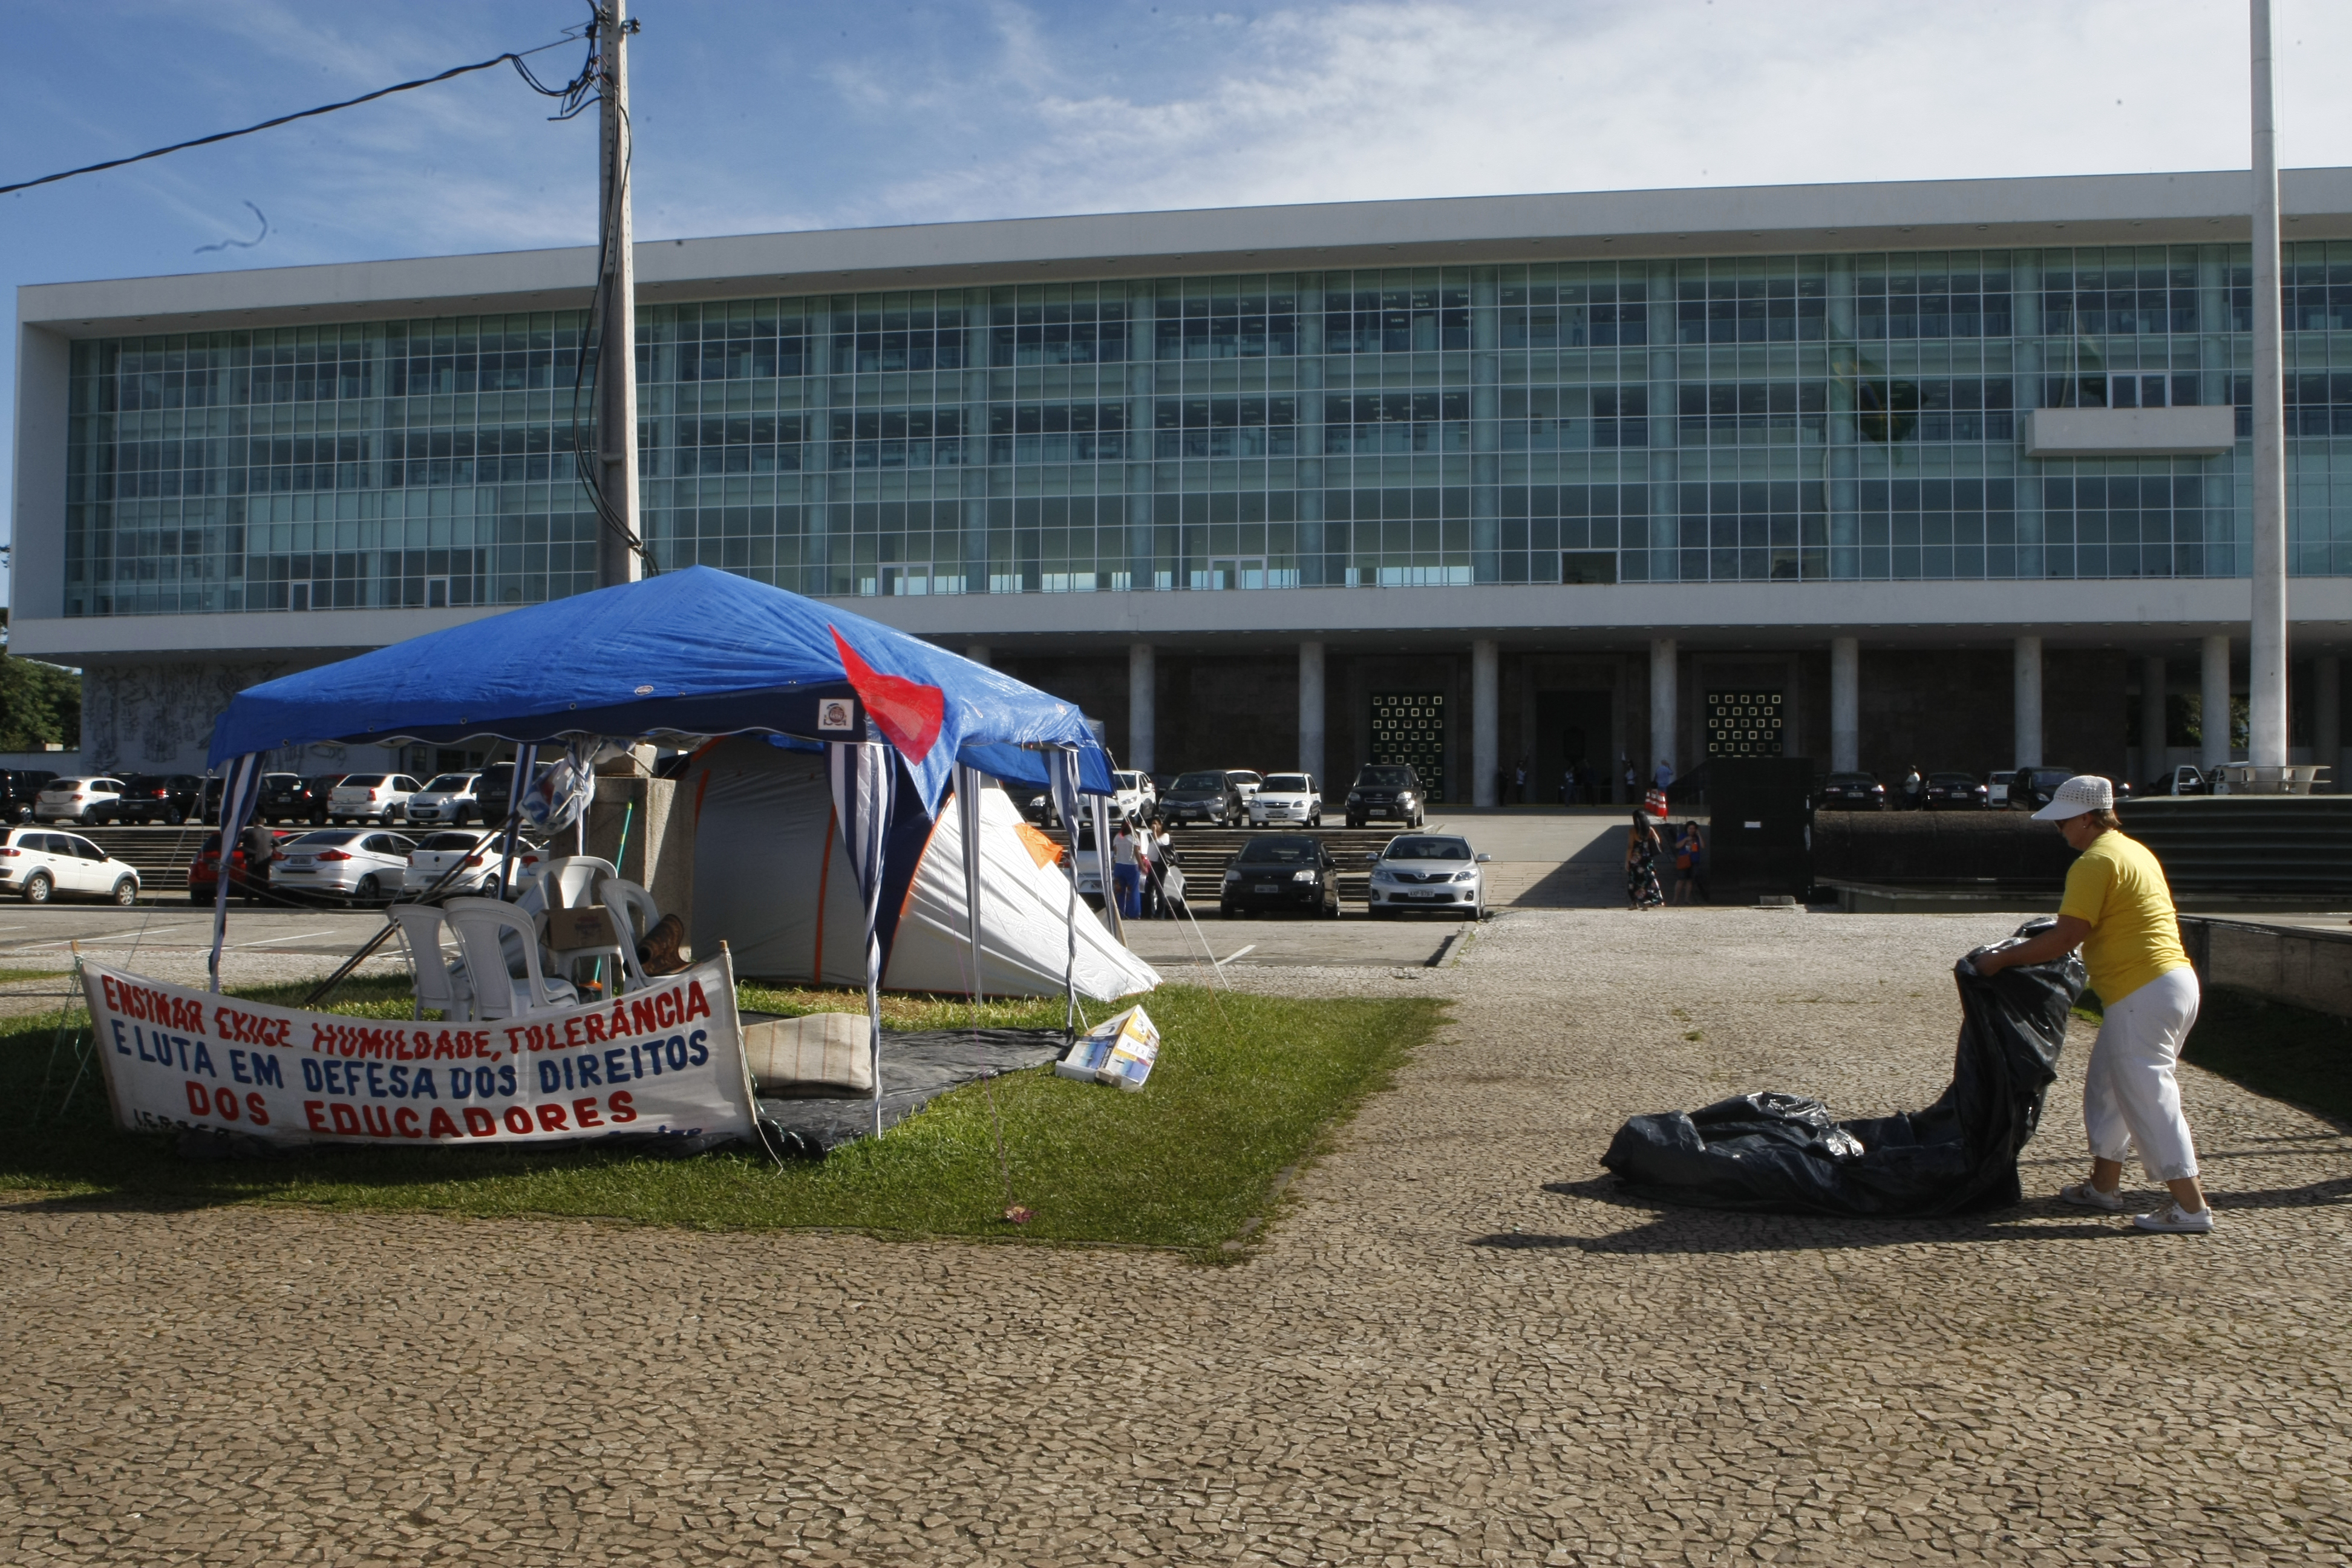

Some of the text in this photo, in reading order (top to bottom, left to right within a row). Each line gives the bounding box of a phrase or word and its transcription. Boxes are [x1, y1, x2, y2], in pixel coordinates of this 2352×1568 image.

[101, 973, 711, 1062] ENSINAR EXIGE HUMILDADE, TOLERÂNCIA
[229, 1048, 285, 1089] EM
[301, 1057, 439, 1100] DEFESA
[449, 1065, 517, 1100] DOS
[538, 1029, 710, 1094] DIREITOS
[185, 1080, 638, 1138] DOS EDUCADORES
